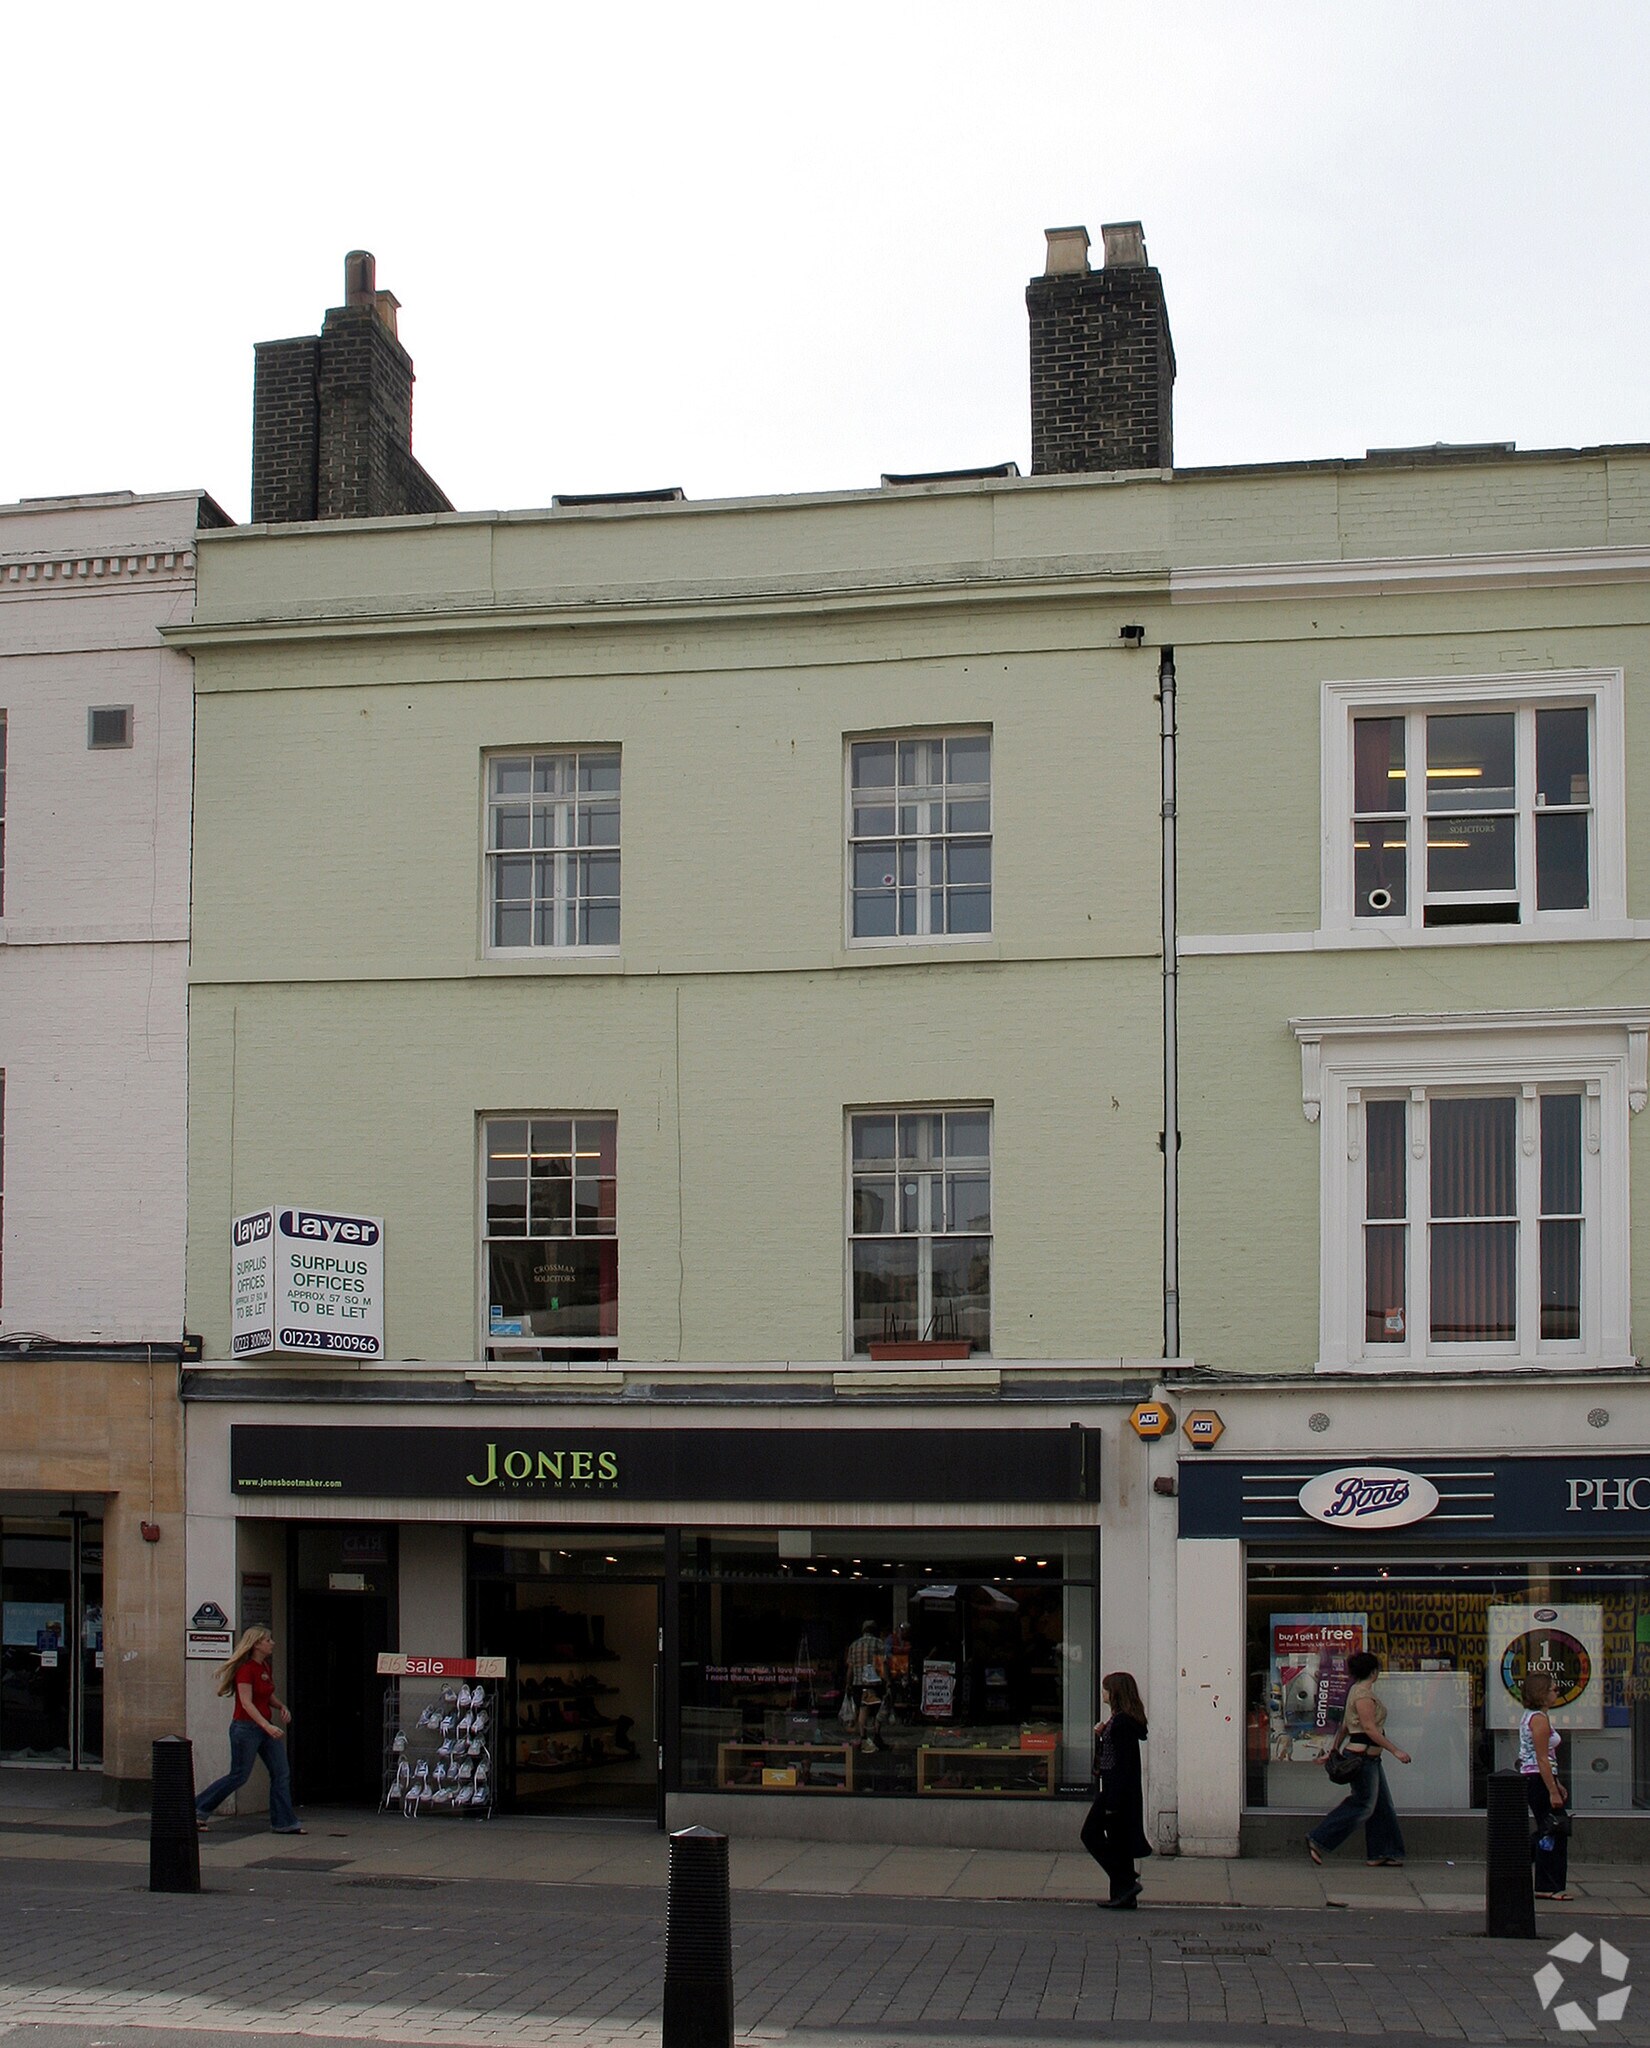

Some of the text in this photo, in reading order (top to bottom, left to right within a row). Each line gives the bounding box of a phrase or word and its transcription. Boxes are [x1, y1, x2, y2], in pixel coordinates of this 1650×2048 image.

[1449, 825, 1496, 834] SOLICITORS
[237, 1214, 271, 1243] layer
[291, 1211, 376, 1243] layer
[236, 1256, 267, 1276] SURPLUS
[291, 1254, 368, 1275] SURPLUS
[533, 1264, 576, 1274] CROSSMAN
[237, 1275, 266, 1293] OFFICES
[293, 1273, 365, 1293] OFFICES
[533, 1275, 577, 1283] SOLICITORS
[287, 1290, 372, 1306] APPROX 57 SQ M
[236, 1302, 267, 1319] TO BE LET
[290, 1300, 368, 1319] TO BE LET
[283, 1330, 376, 1352] 01223 300966
[1139, 1414, 1158, 1423] ADT
[1193, 1422, 1213, 1432] ADT
[466, 1443, 619, 1487] JONES
[238, 1478, 342, 1489] www.jonesbootmaker.com
[499, 1481, 620, 1490] BOOTMAKER
[1323, 1478, 1411, 1517] Boots
[1278, 1633, 1294, 1642] buy
[1300, 1633, 1314, 1642] get
[1320, 1627, 1354, 1640] free
[1540, 1640, 1552, 1661] 1
[405, 1658, 444, 1674] sale
[477, 1658, 501, 1674] £15
[705, 1665, 728, 1673] Shoes
[1527, 1661, 1566, 1671] HOUR
[1316, 1680, 1330, 1728] camera
